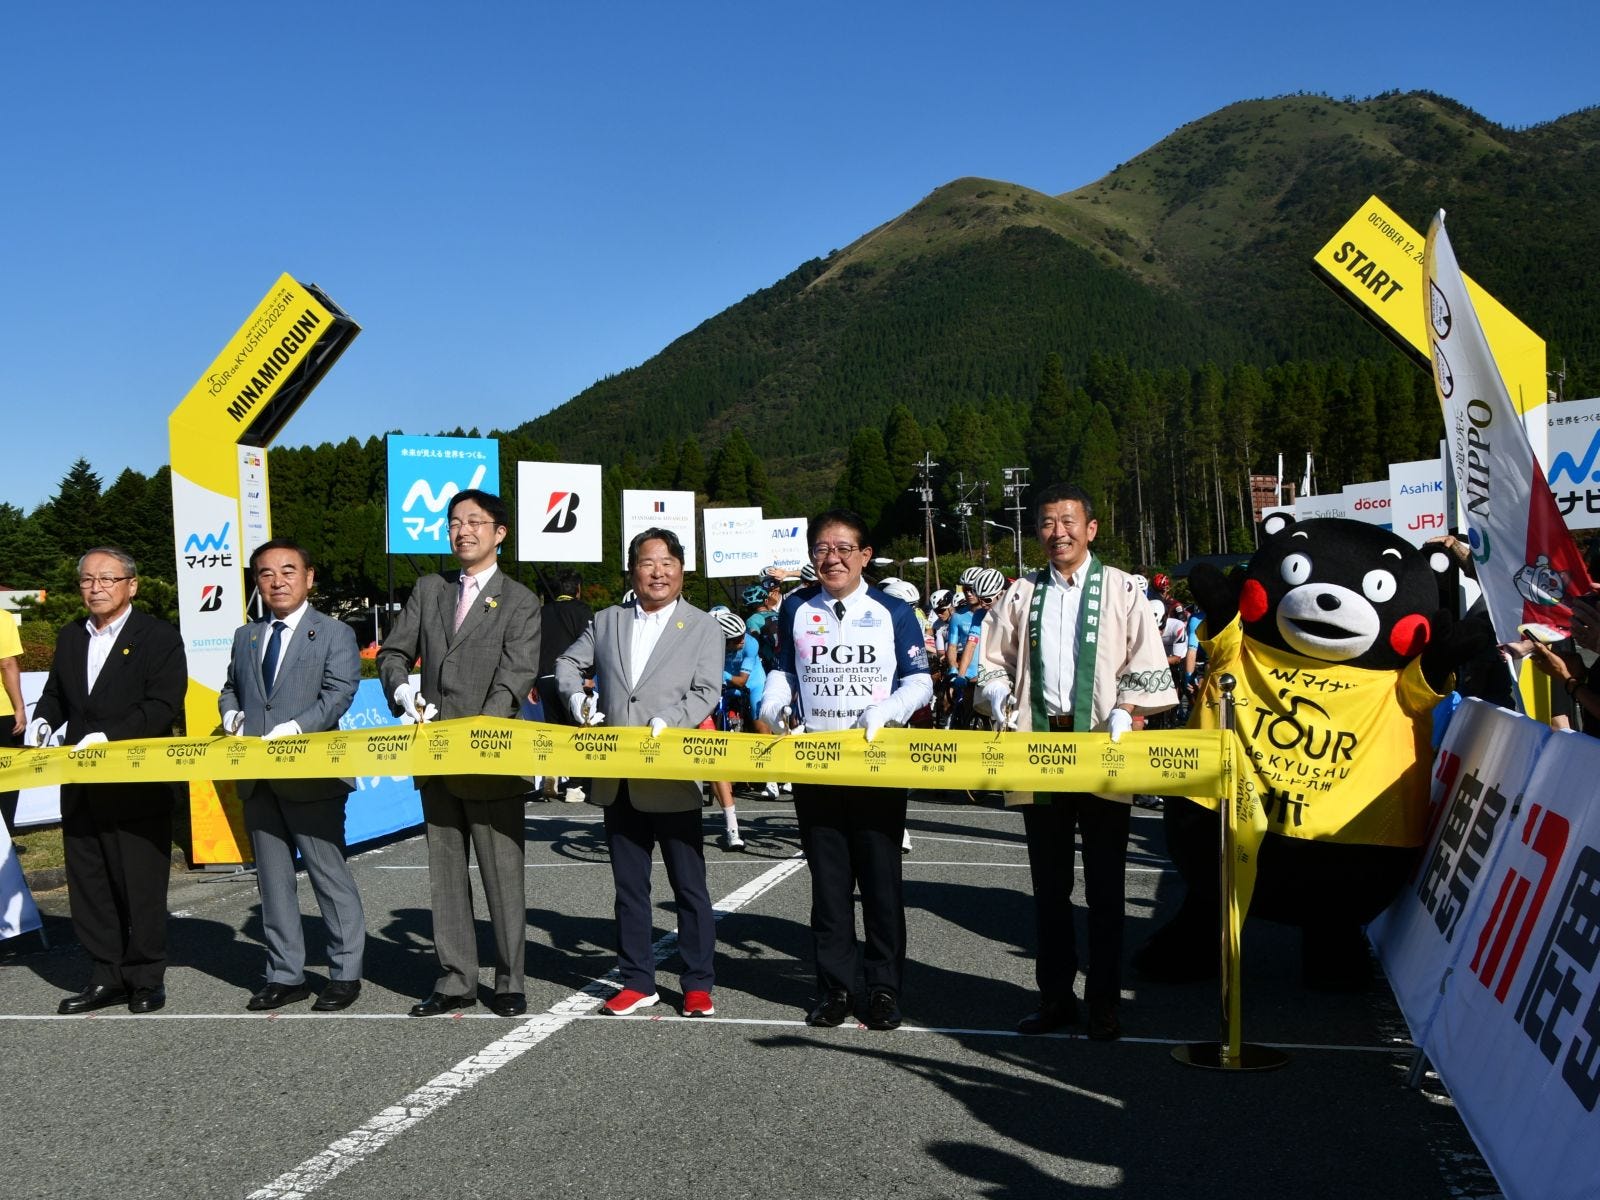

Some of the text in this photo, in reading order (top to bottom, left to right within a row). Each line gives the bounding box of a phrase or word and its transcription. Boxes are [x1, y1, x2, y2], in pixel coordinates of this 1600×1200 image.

[1368, 212, 1404, 246] OCTOBER
[1402, 242, 1415, 257] 12,
[1333, 241, 1404, 303] START
[226, 309, 321, 423] MINAMIOGUNI
[1467, 399, 1493, 521] NIPPO
[1552, 489, 1600, 516] ナビ
[402, 517, 450, 541] マイ
[772, 528, 790, 538] ANA
[184, 553, 232, 569] マイナビ
[1085, 573, 1101, 643] 南小国町長
[810, 644, 876, 665] PGB
[805, 665, 881, 674] Parliamentary
[802, 674, 888, 684] Group of Bicycle
[812, 684, 873, 697] JAPAN
[339, 708, 388, 730] をつくる。
[470, 730, 513, 739] MINAMI
[574, 733, 619, 742] MINAMI
[1251, 706, 1358, 764] TOUR
[327, 742, 347, 750] TOUR
[429, 739, 450, 747] TOUR
[470, 739, 511, 750] OGUNI
[533, 739, 553, 747] TOUR
[575, 741, 617, 752] OGUNI
[683, 737, 728, 746] MINAMI
[794, 741, 841, 750] MINAMI
[267, 745, 307, 755] OGUNI
[367, 742, 408, 752] OGUNI
[683, 745, 727, 757] OGUNI
[909, 743, 957, 752] MINAMI
[1028, 744, 1077, 753] MINAMI
[68, 750, 106, 759] OGUNI
[166, 748, 206, 757] OGUNI
[795, 750, 840, 761] OGUNI
[864, 751, 886, 759] TOUR
[981, 753, 1004, 761] TOUR
[1148, 747, 1199, 758] MINAMI
[911, 753, 957, 763] OGUNI
[1029, 755, 1076, 765] OGUNI
[1101, 754, 1125, 762] TOUR
[1245, 745, 1350, 779] de KYUSHU
[1150, 758, 1198, 770] OGUNI
